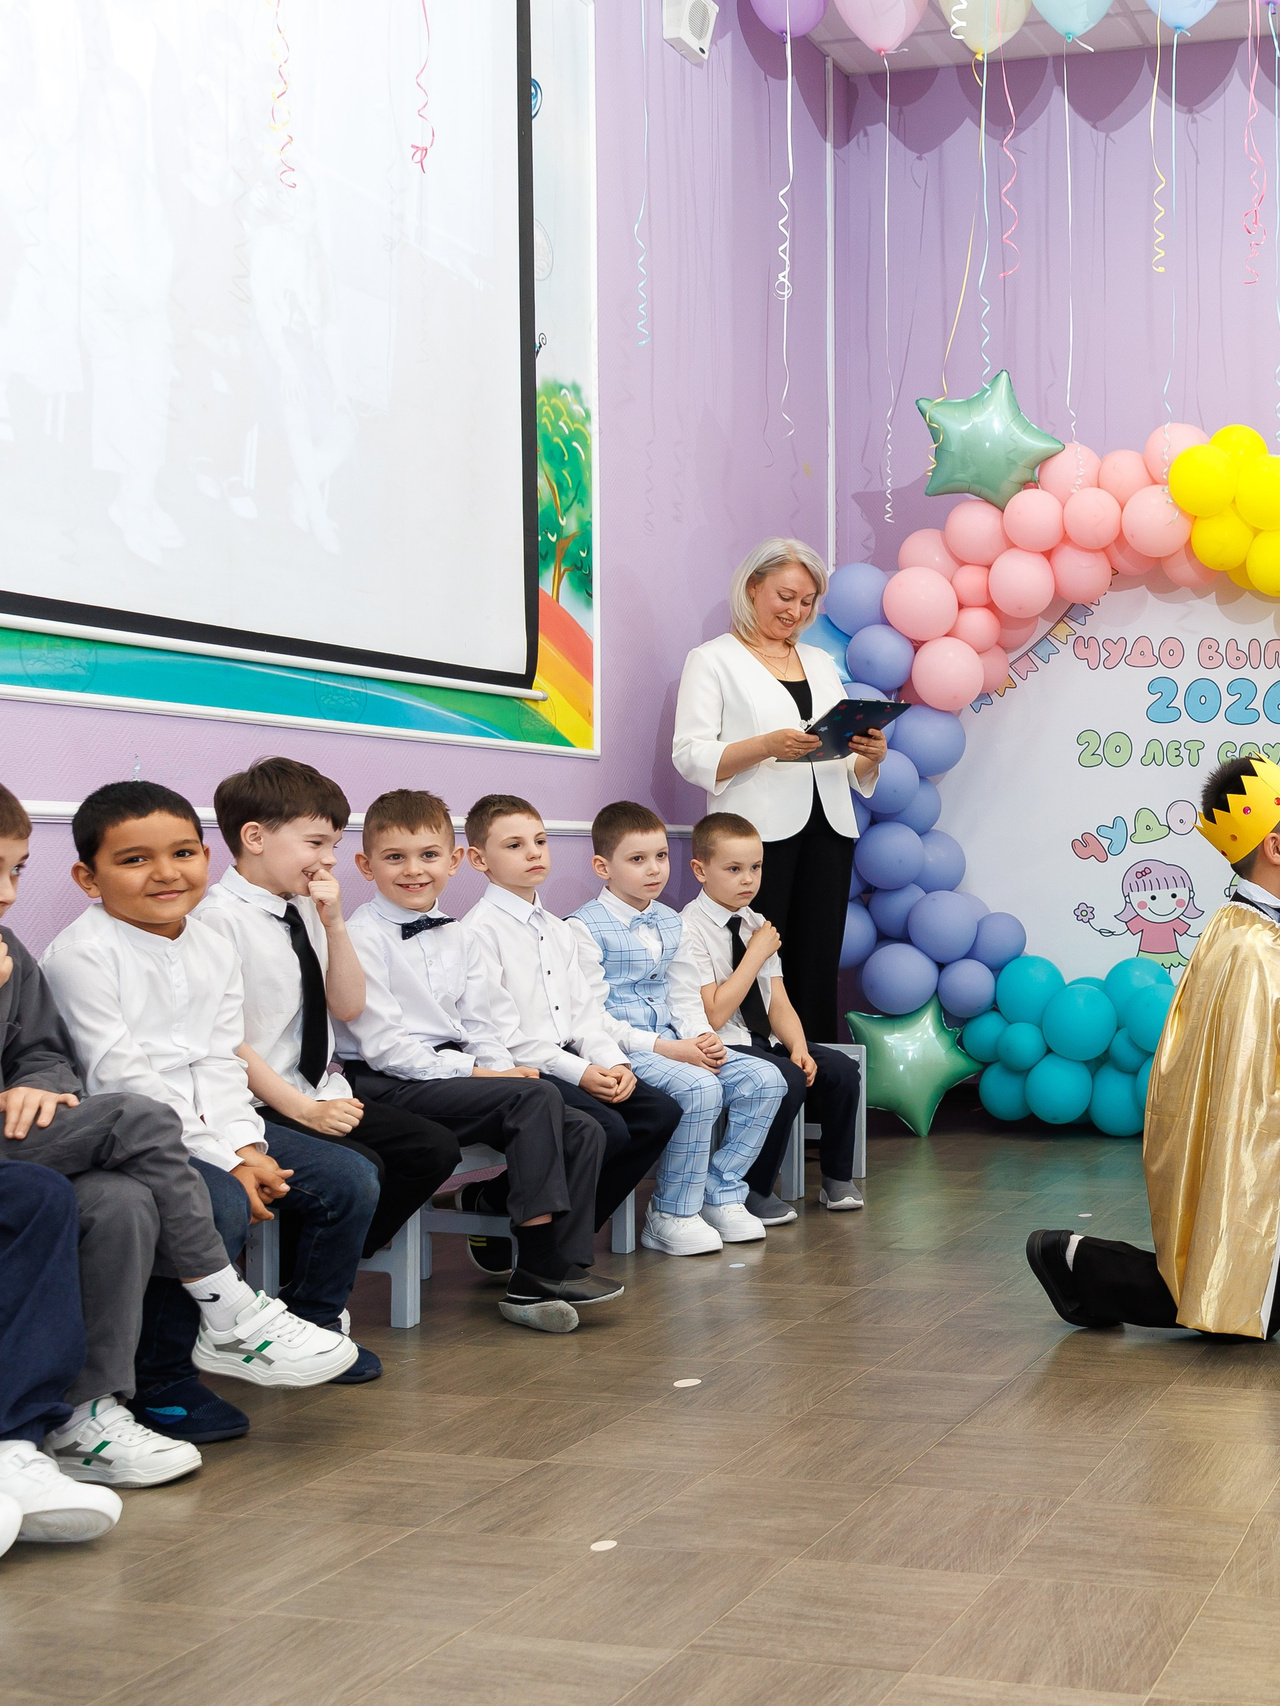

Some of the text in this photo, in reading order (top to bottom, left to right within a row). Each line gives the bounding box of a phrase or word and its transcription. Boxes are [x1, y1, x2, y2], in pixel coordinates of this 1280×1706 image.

[1073, 635, 1185, 670] ЧУДО
[1076, 729, 1133, 768] 20
[1140, 738, 1205, 767] ЛЕТ
[1071, 799, 1198, 863] ЧУДО
